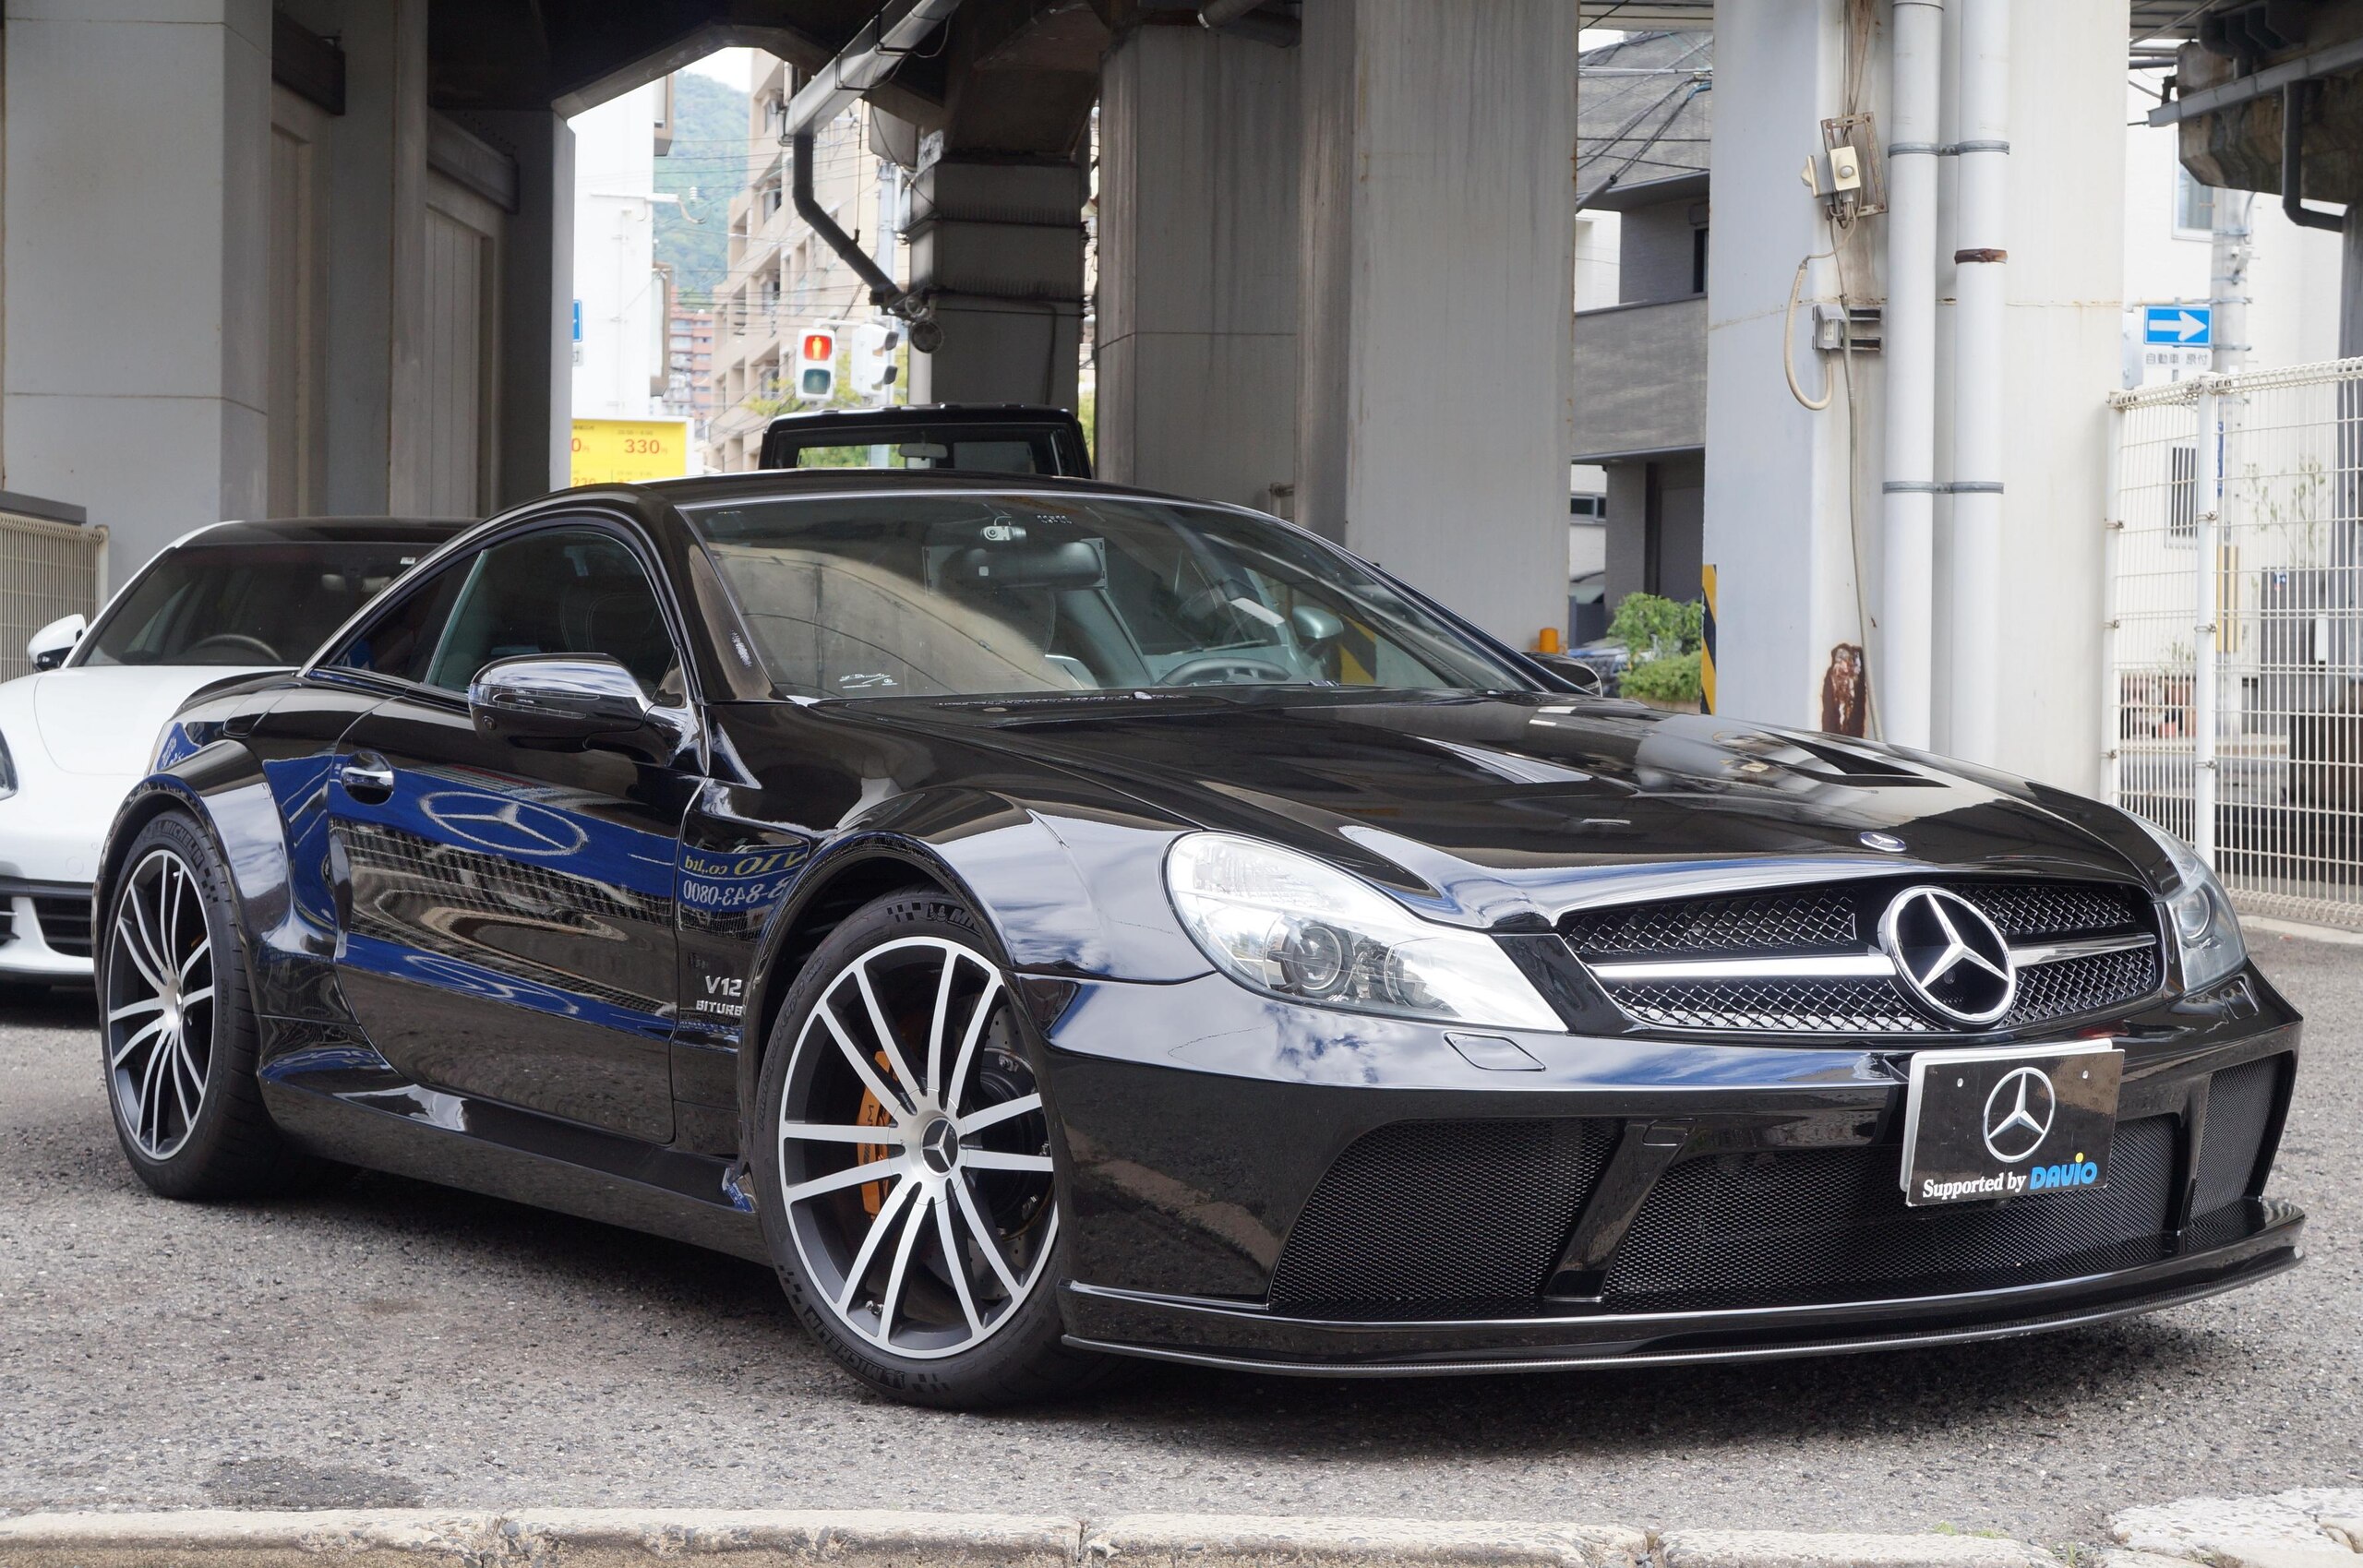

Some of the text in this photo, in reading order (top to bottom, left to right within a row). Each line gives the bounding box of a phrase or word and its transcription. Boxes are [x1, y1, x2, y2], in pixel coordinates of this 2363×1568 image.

[705, 975, 742, 997] V12
[696, 999, 746, 1016] BITURB
[1923, 1172, 2003, 1201] Supported
[2007, 1171, 2027, 1193] by
